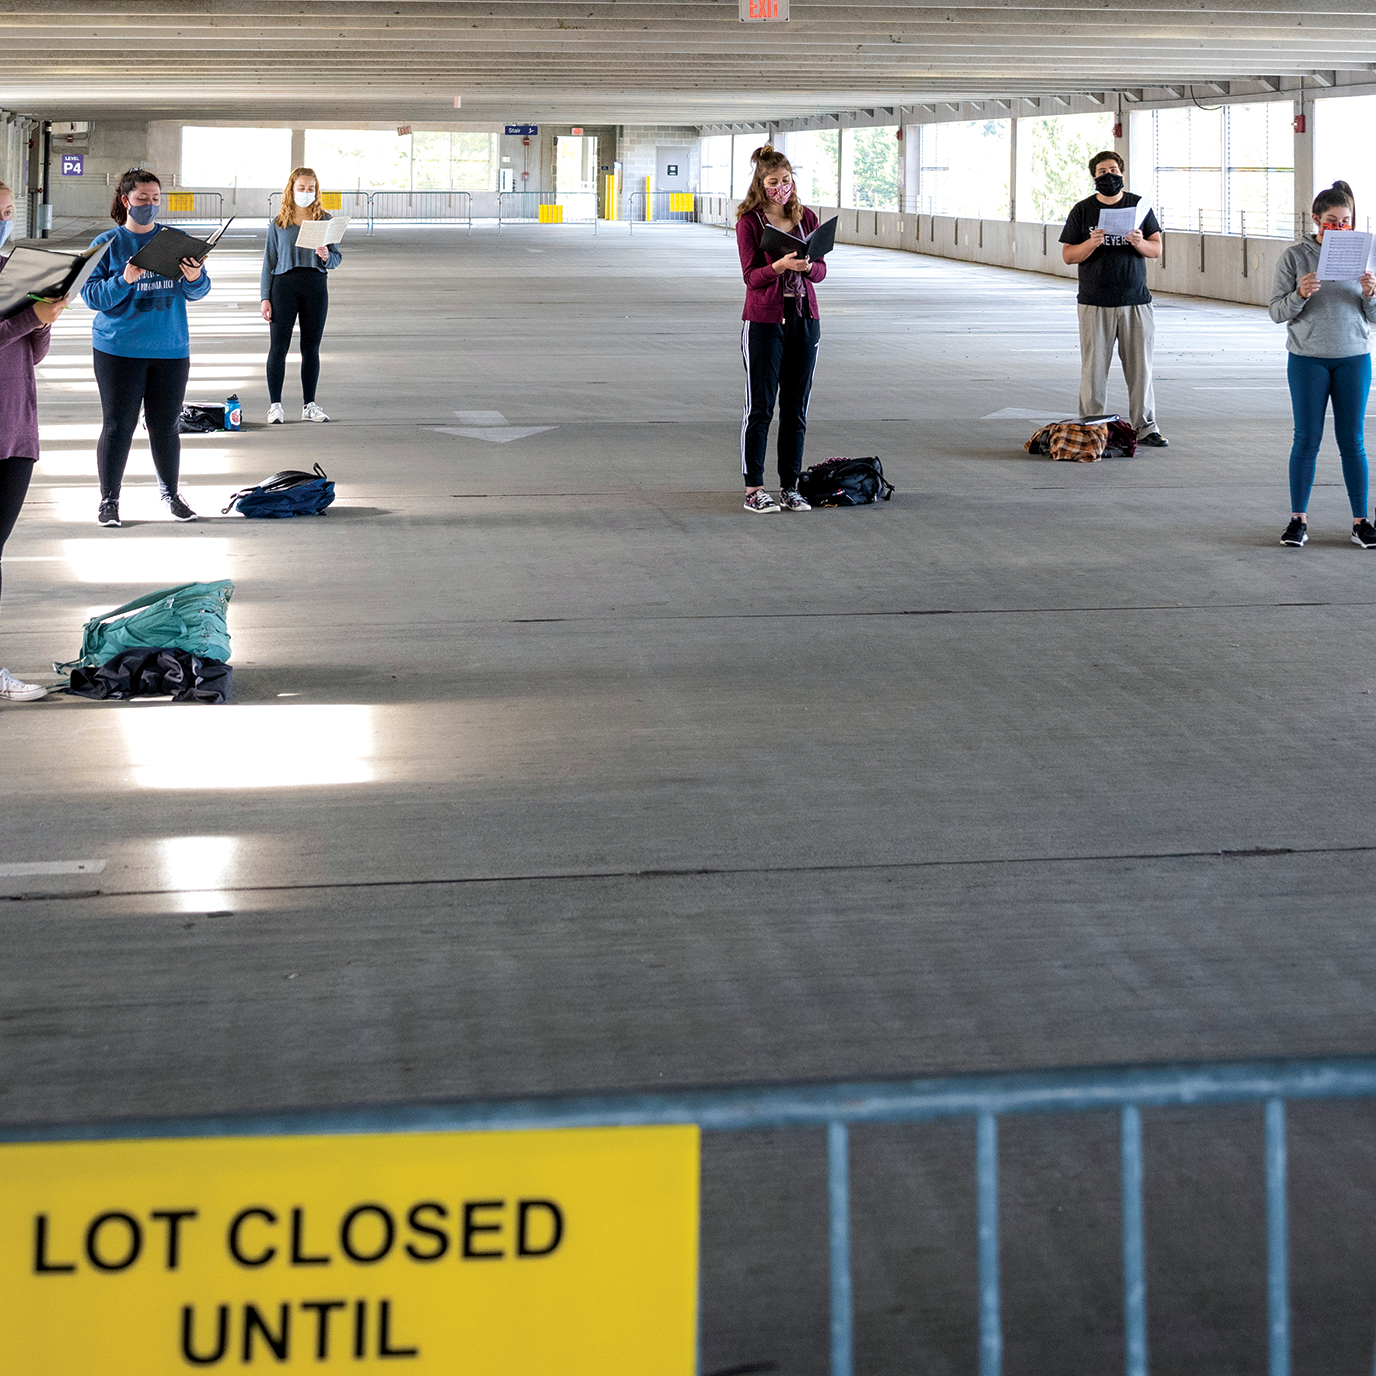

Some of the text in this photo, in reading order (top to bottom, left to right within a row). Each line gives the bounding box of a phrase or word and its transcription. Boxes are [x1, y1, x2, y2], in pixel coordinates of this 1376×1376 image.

[64, 162, 81, 174] P4
[32, 1198, 567, 1276] LOT CLOSED
[180, 1298, 420, 1368] UNTIL
